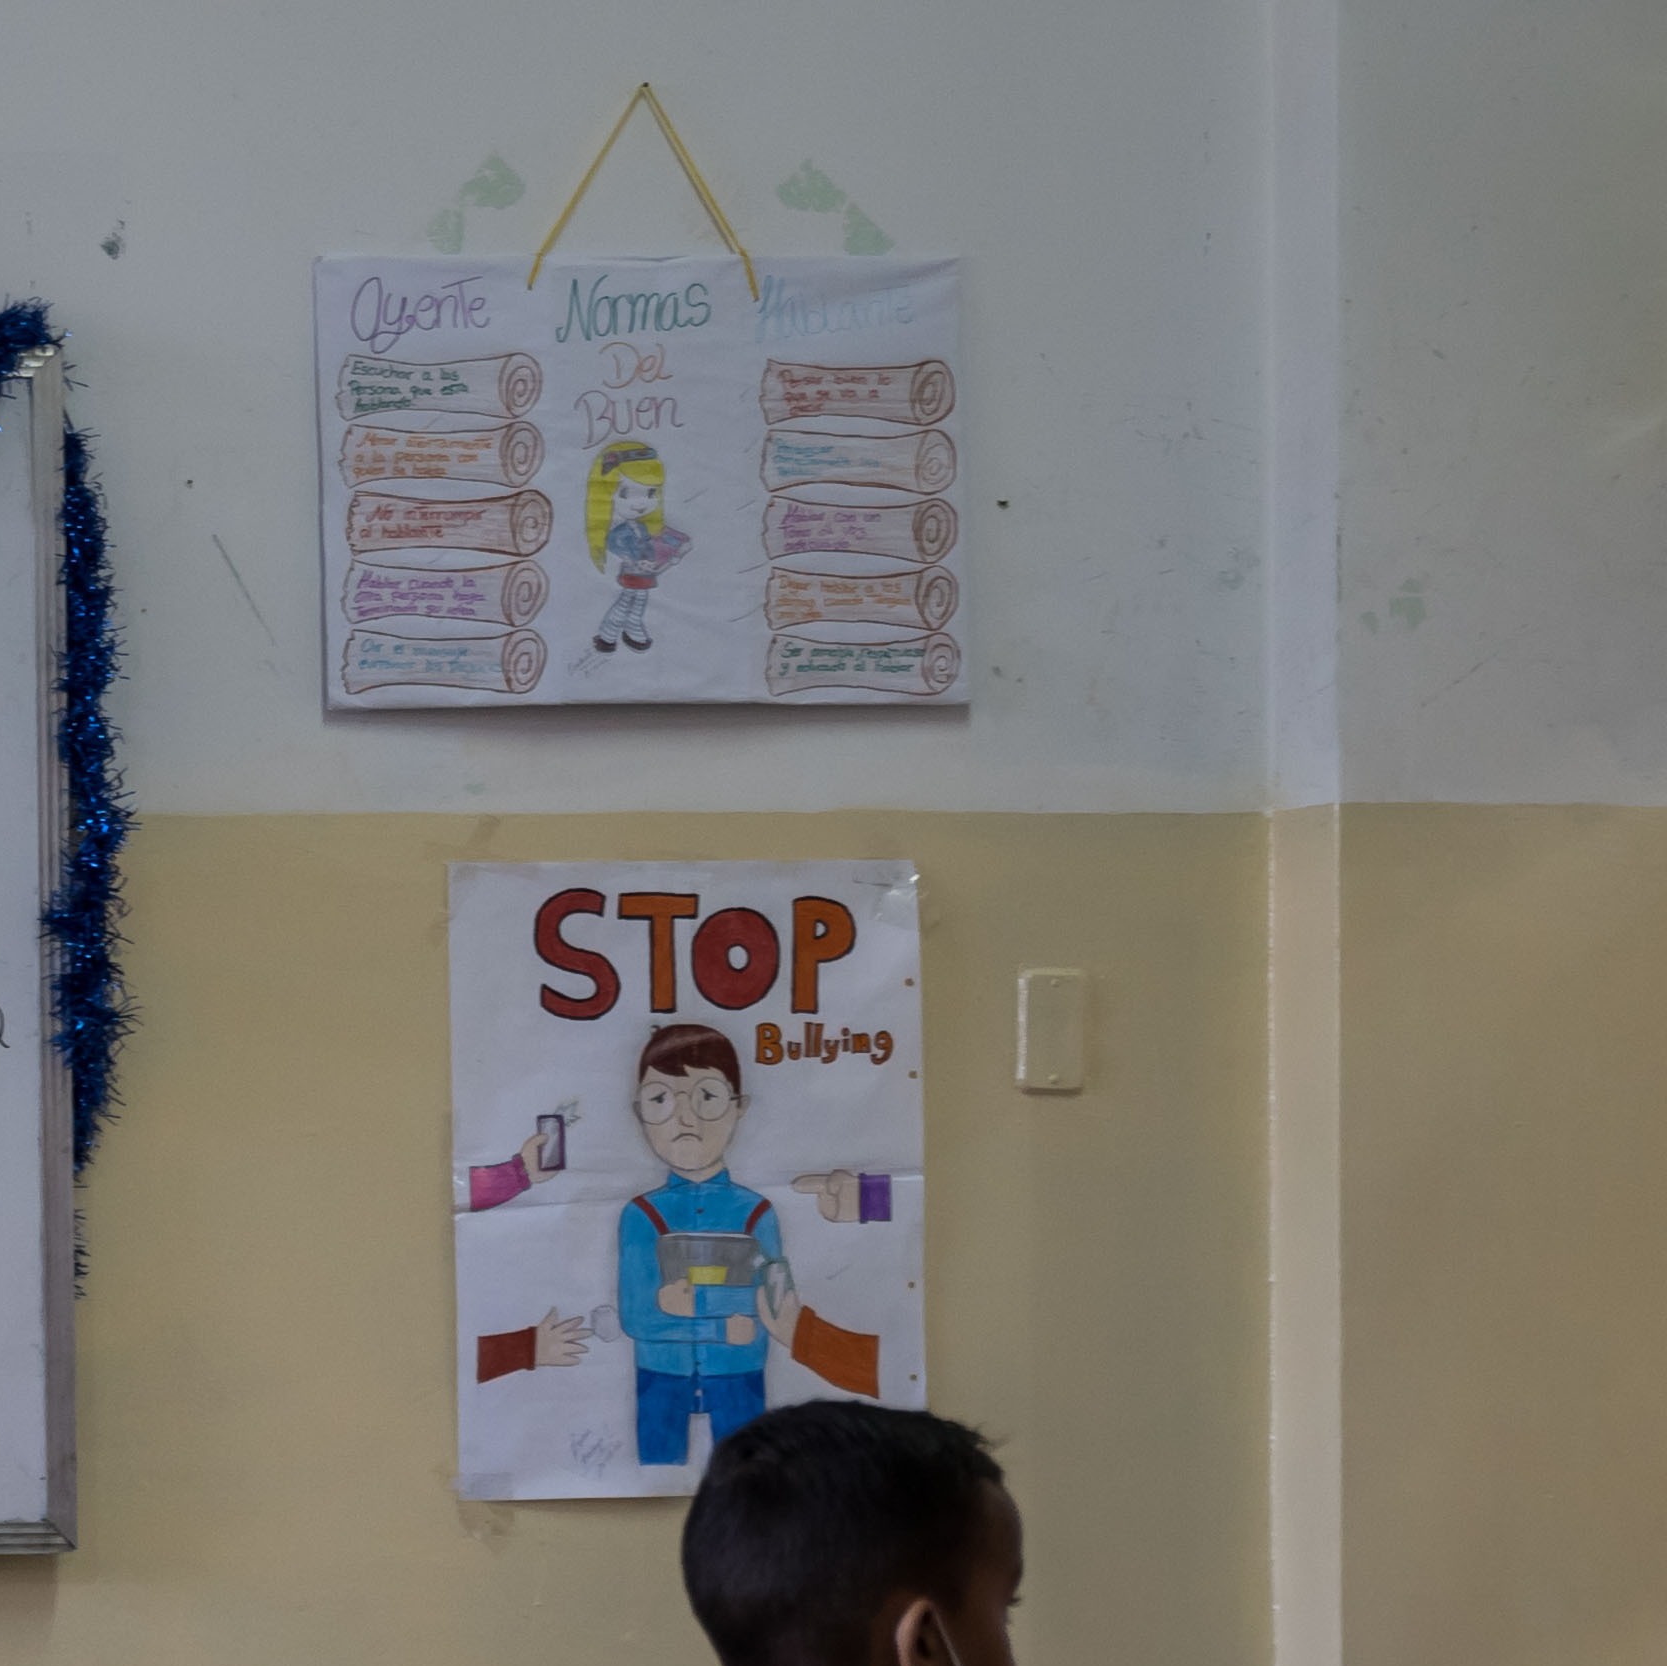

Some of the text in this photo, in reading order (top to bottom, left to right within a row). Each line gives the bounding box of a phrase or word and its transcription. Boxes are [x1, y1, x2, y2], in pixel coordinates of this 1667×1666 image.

[555, 273, 712, 344] Normas
[598, 341, 674, 389] Del
[573, 389, 685, 450] Buen
[533, 887, 857, 1021] STOP
[755, 1021, 894, 1066] Bullying
